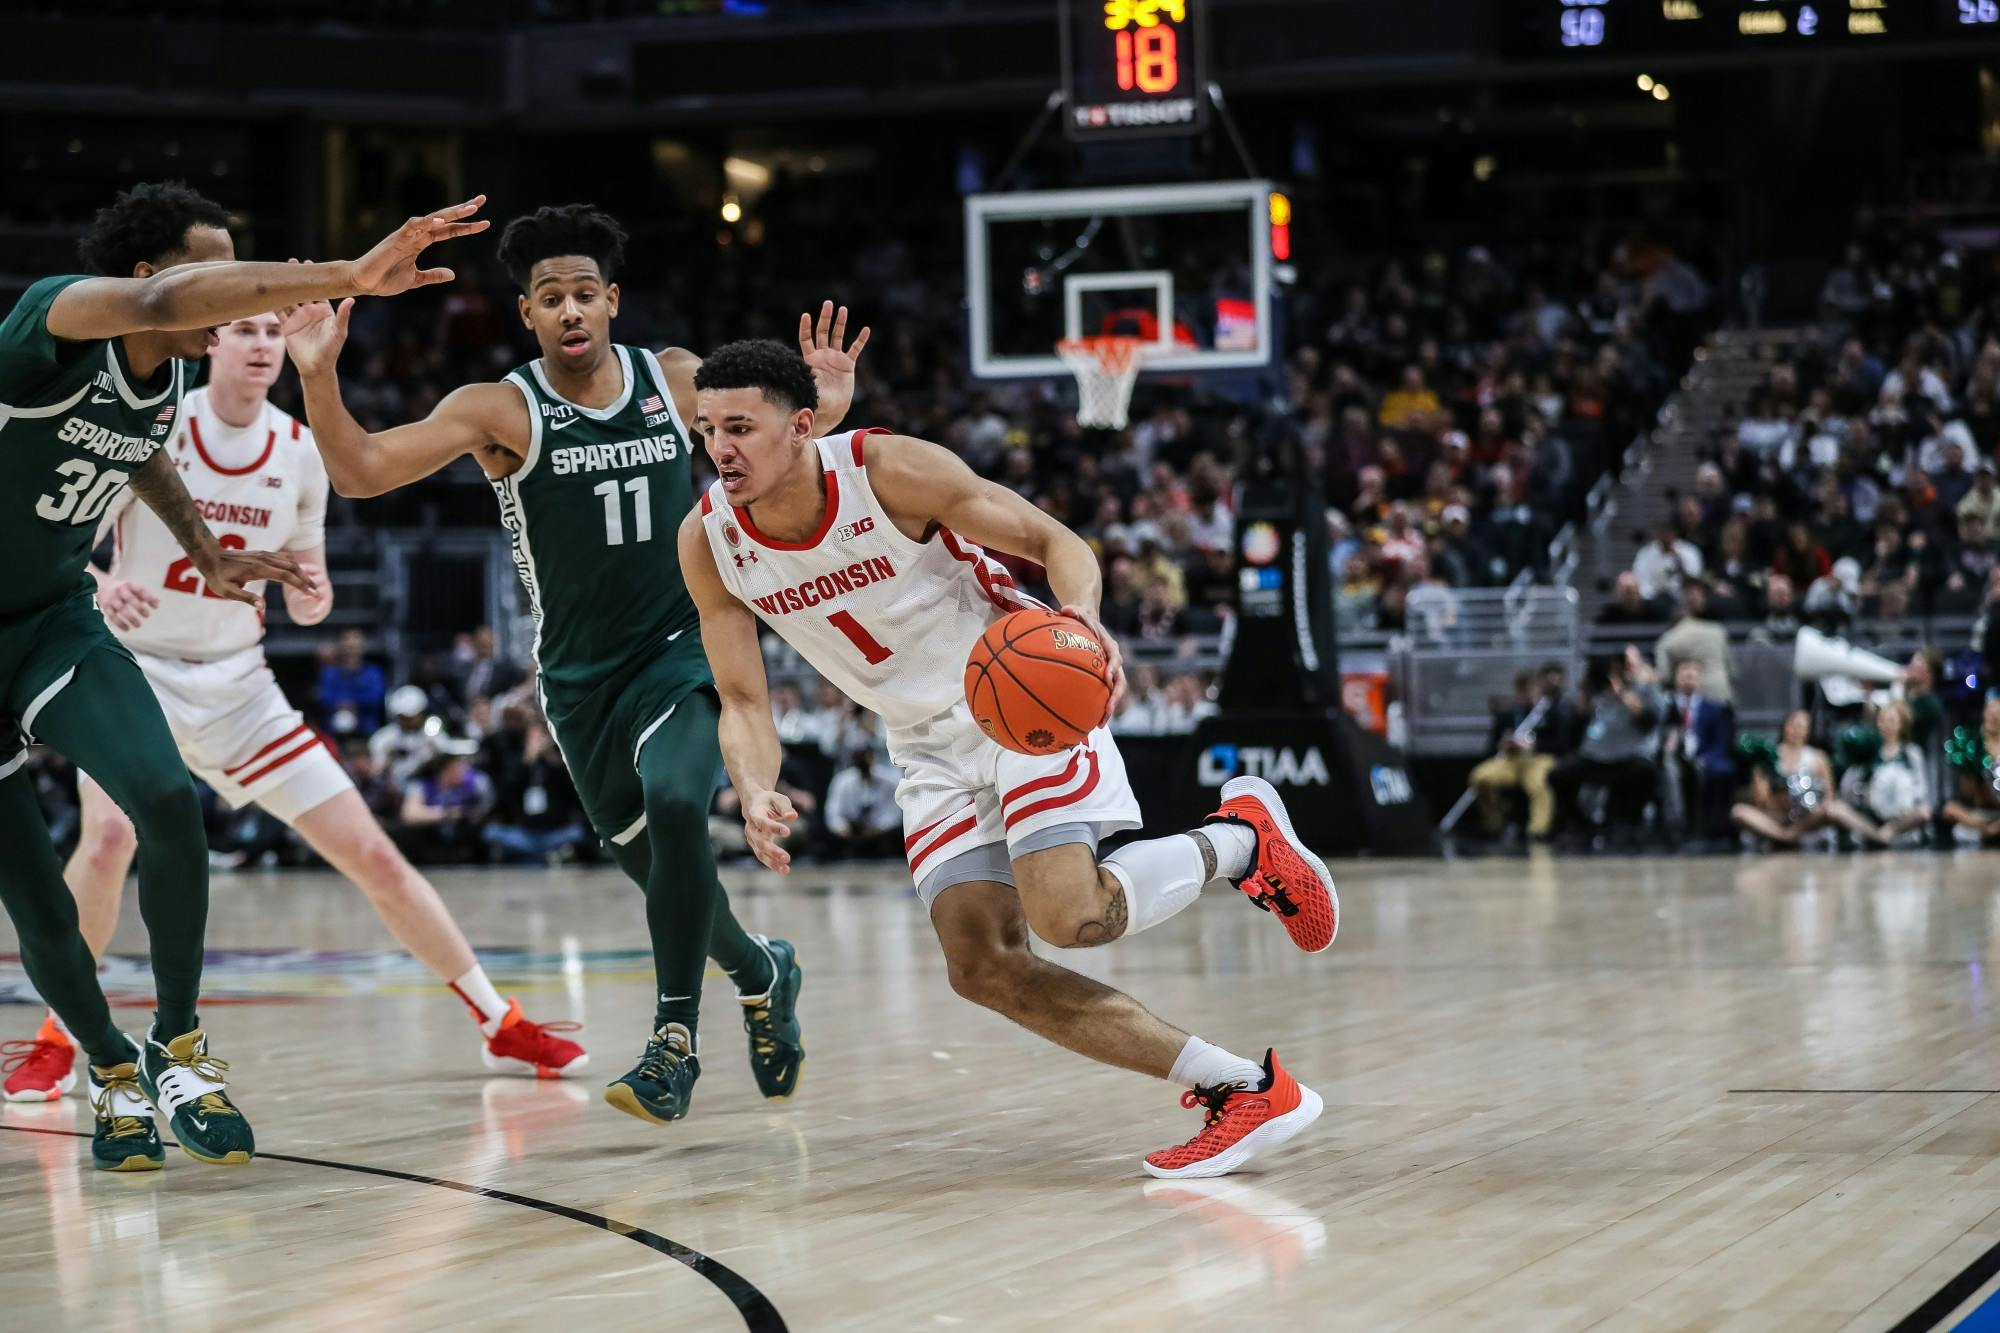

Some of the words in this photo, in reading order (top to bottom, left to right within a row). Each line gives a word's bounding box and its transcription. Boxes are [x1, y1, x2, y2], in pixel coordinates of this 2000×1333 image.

[1116, 23, 1178, 93] 18
[57, 417, 161, 462] SPARTANS
[551, 433, 677, 475] SPARTANS
[35, 458, 130, 526] 30
[193, 499, 272, 528] SCONSIN
[593, 476, 652, 546] 11
[752, 555, 897, 615] WISCONSIN
[826, 609, 894, 665] 1
[1238, 746, 1330, 786] TIAA
